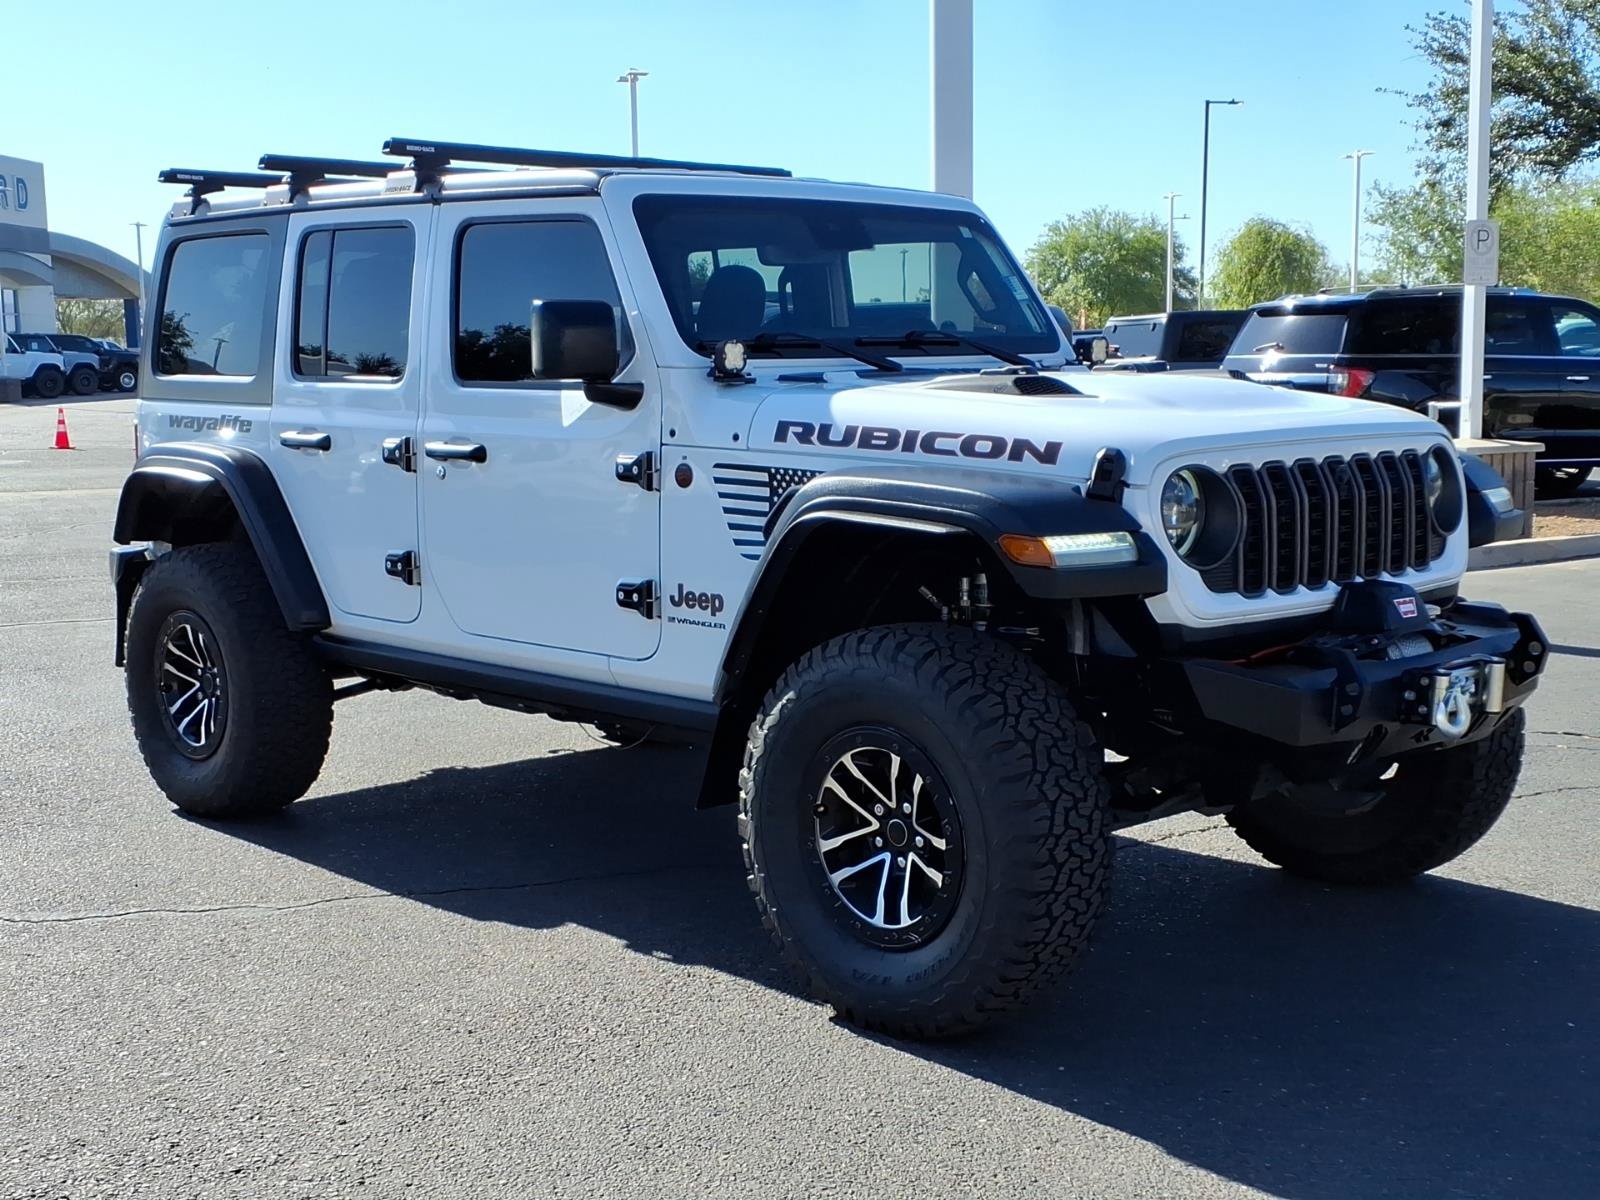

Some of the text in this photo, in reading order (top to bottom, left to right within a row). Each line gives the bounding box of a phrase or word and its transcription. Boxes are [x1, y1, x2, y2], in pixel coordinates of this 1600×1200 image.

[1477, 229, 1490, 250] P
[168, 414, 253, 433] wayalife
[773, 420, 1064, 466] RUBICON
[669, 583, 724, 617] Jeep
[676, 617, 726, 630] WRANGLER
